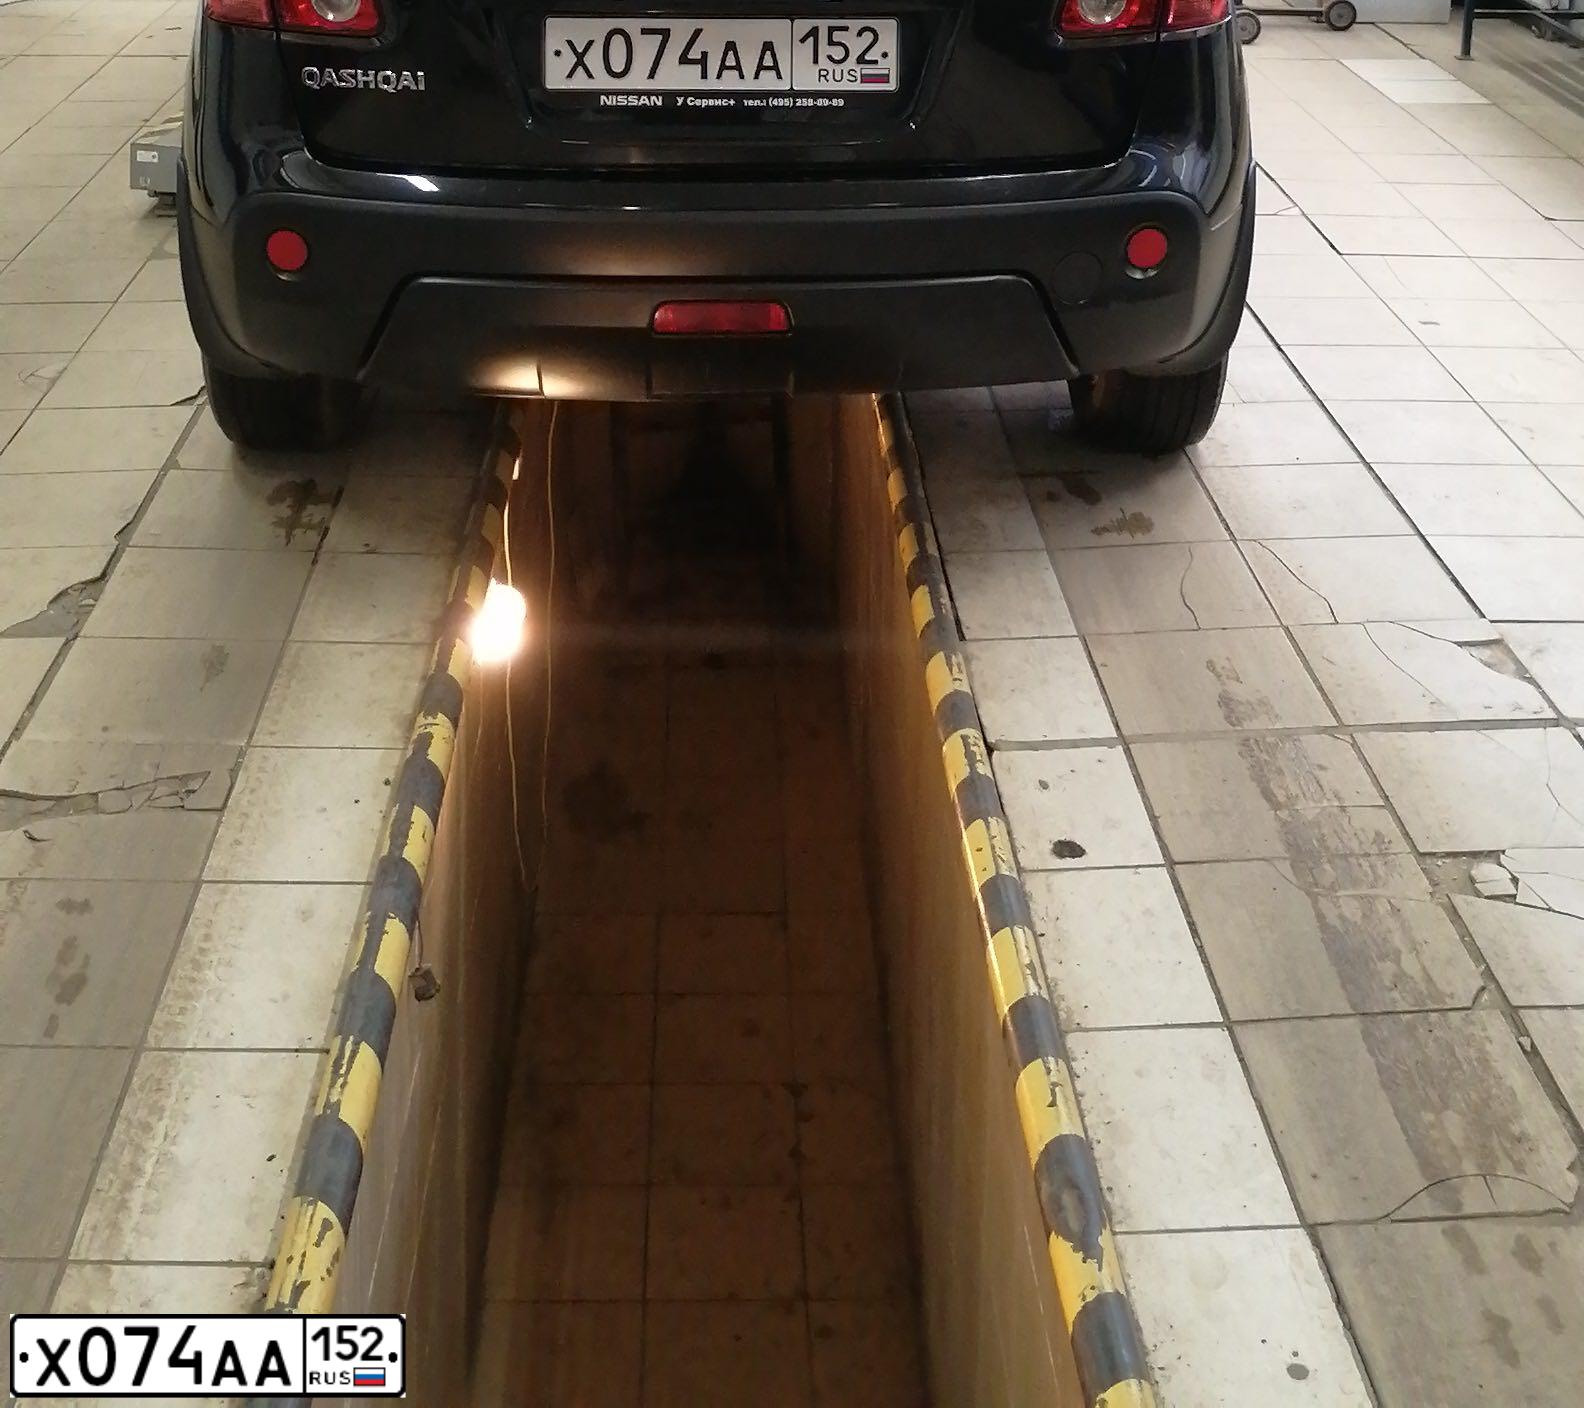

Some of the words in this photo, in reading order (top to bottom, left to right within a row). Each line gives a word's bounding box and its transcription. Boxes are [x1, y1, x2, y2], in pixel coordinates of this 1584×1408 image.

[799, 25, 881, 65] 152
[818, 69, 858, 83] RUS
[600, 95, 663, 107] NISSAN
